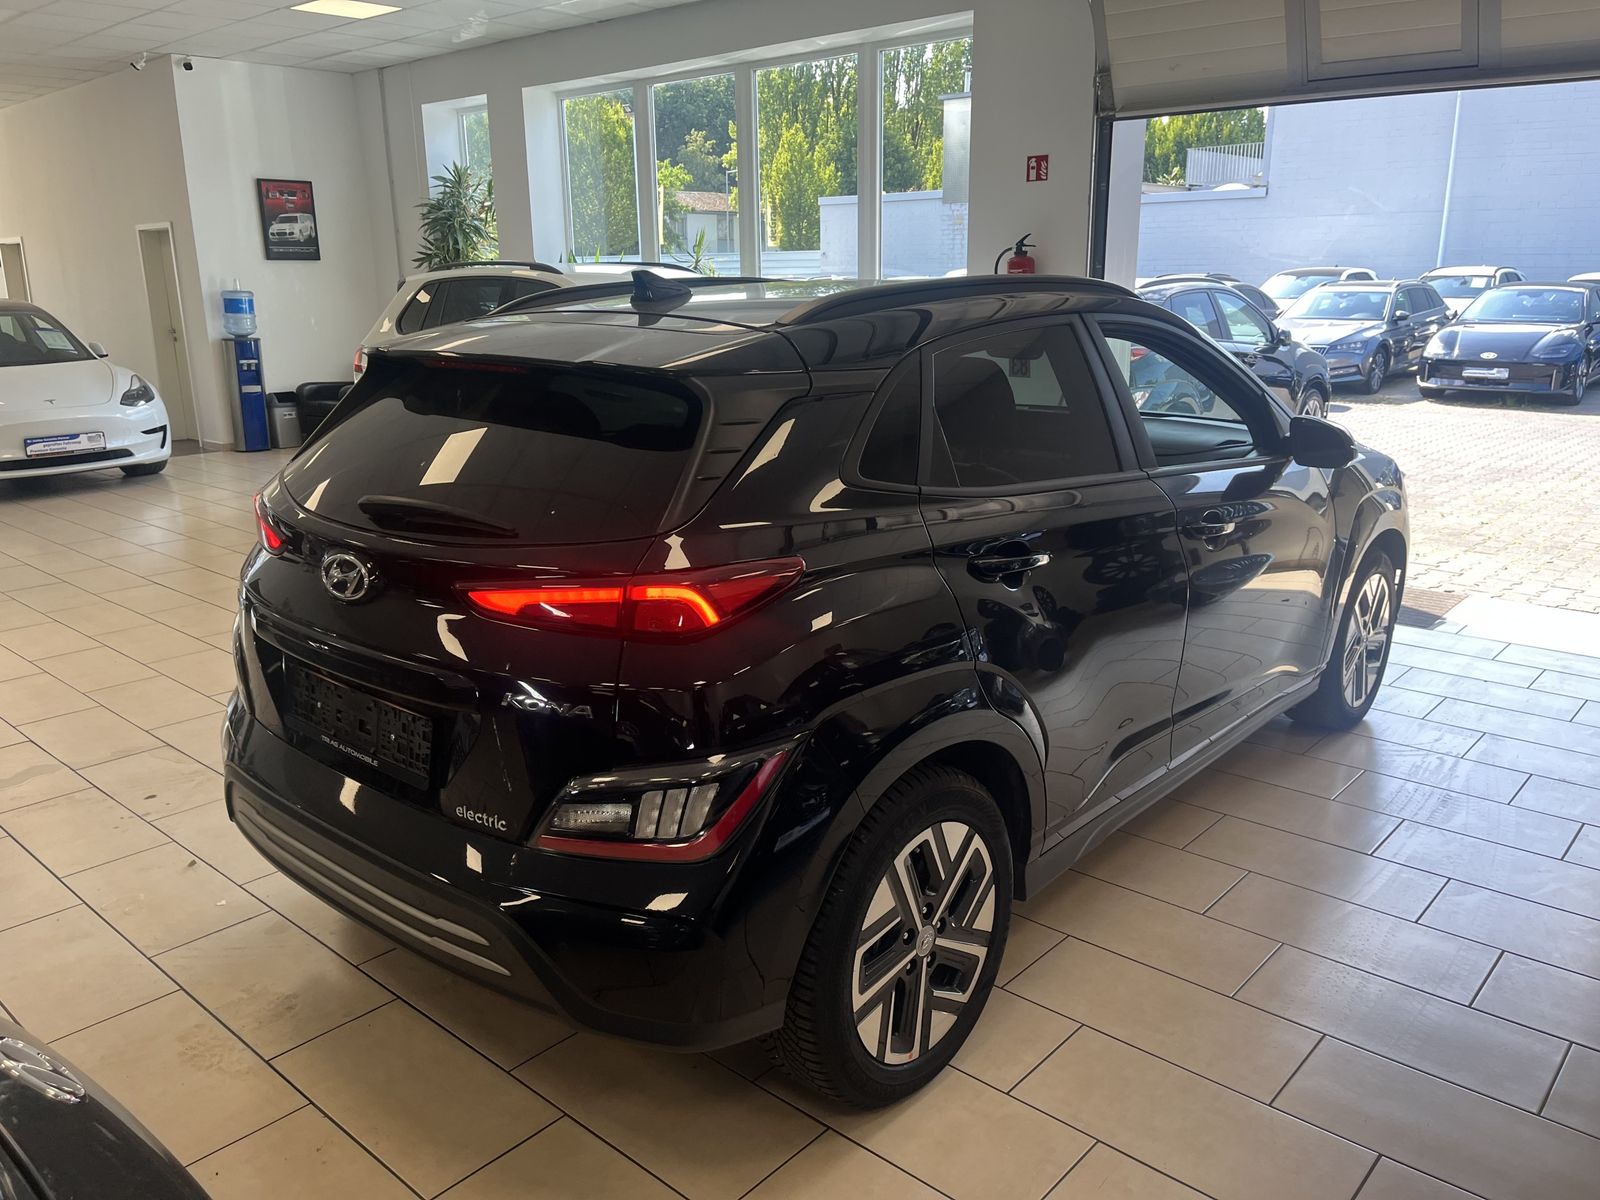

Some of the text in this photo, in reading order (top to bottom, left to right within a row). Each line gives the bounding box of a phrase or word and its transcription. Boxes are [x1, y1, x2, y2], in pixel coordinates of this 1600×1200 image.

[500, 692, 593, 719] KONA
[339, 743, 379, 767] AUTOMOBILE
[455, 805, 507, 831] electric
